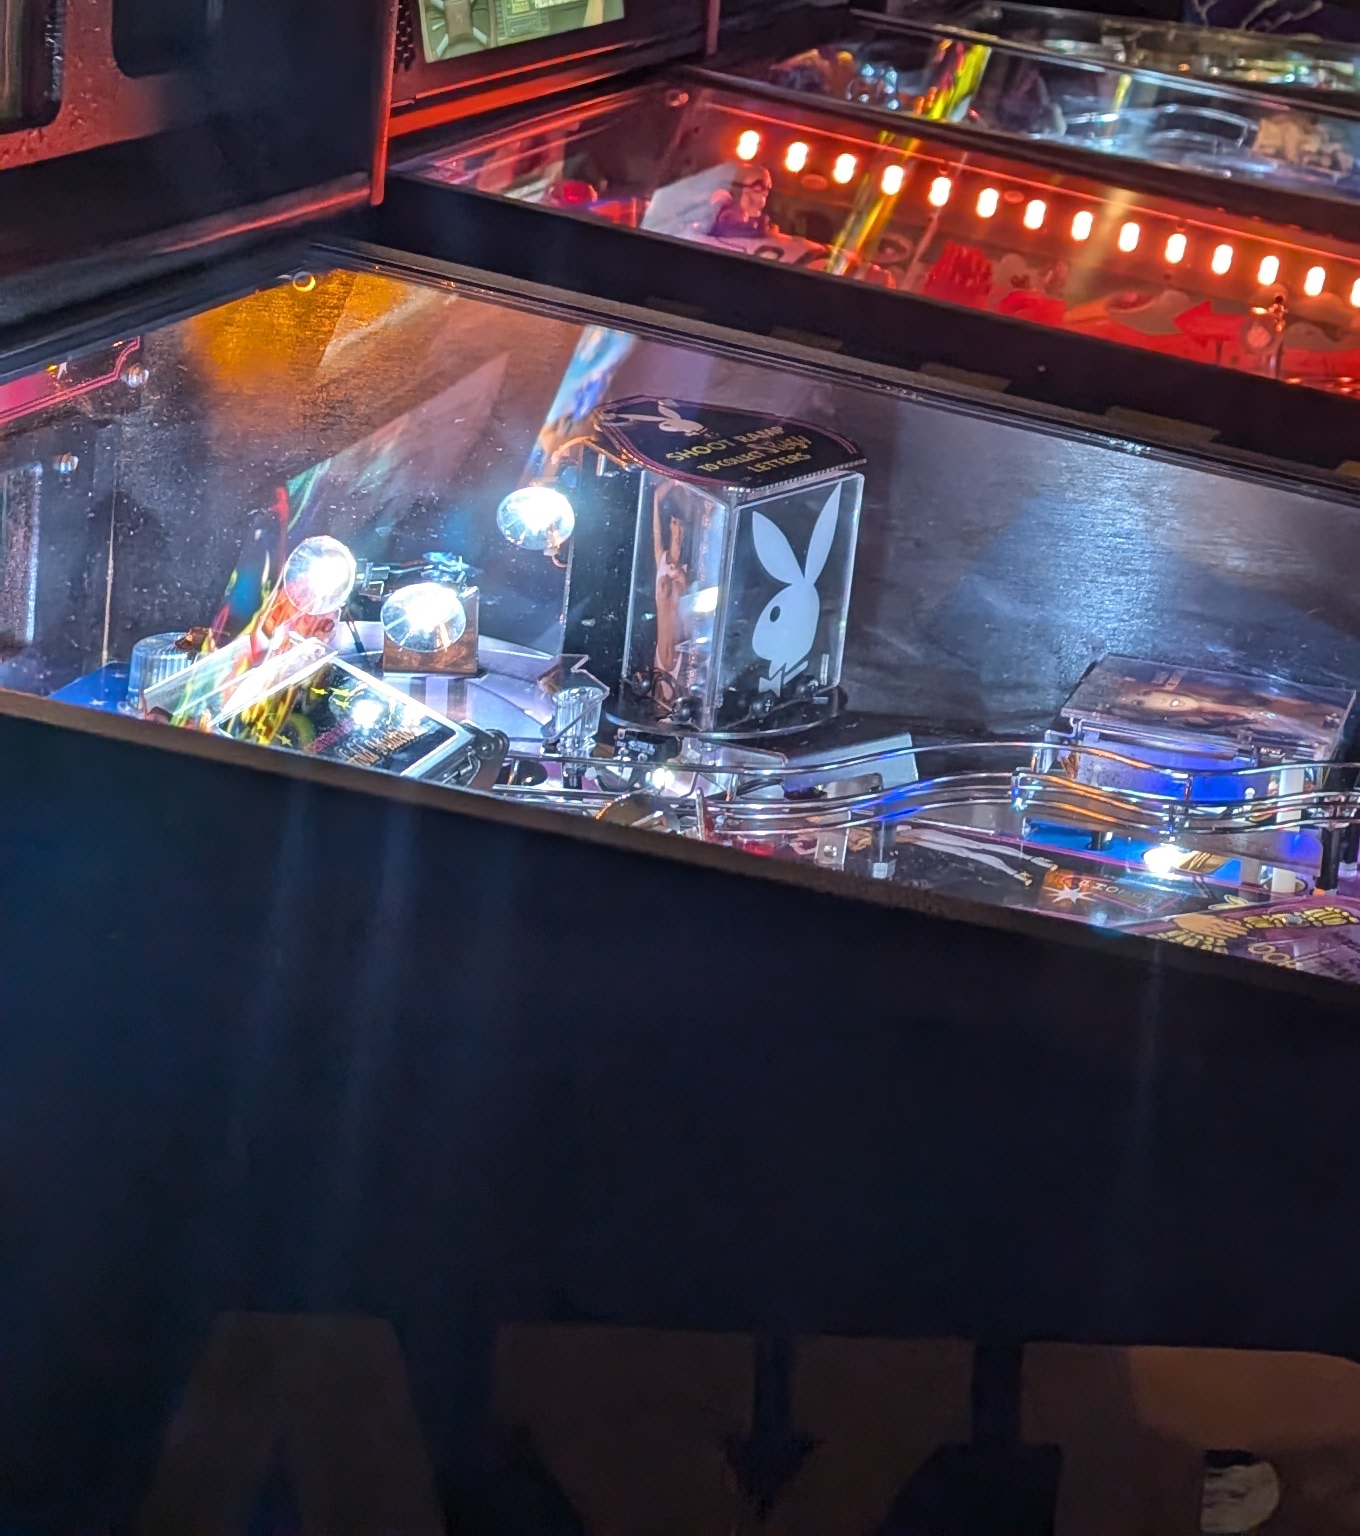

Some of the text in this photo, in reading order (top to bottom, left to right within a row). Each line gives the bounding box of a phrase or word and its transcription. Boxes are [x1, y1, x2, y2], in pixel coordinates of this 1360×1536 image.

[666, 439, 736, 461] SHOOT
[697, 463, 716, 473] TO
[715, 450, 766, 468] COLLECT
[747, 452, 813, 473] LETTERS
